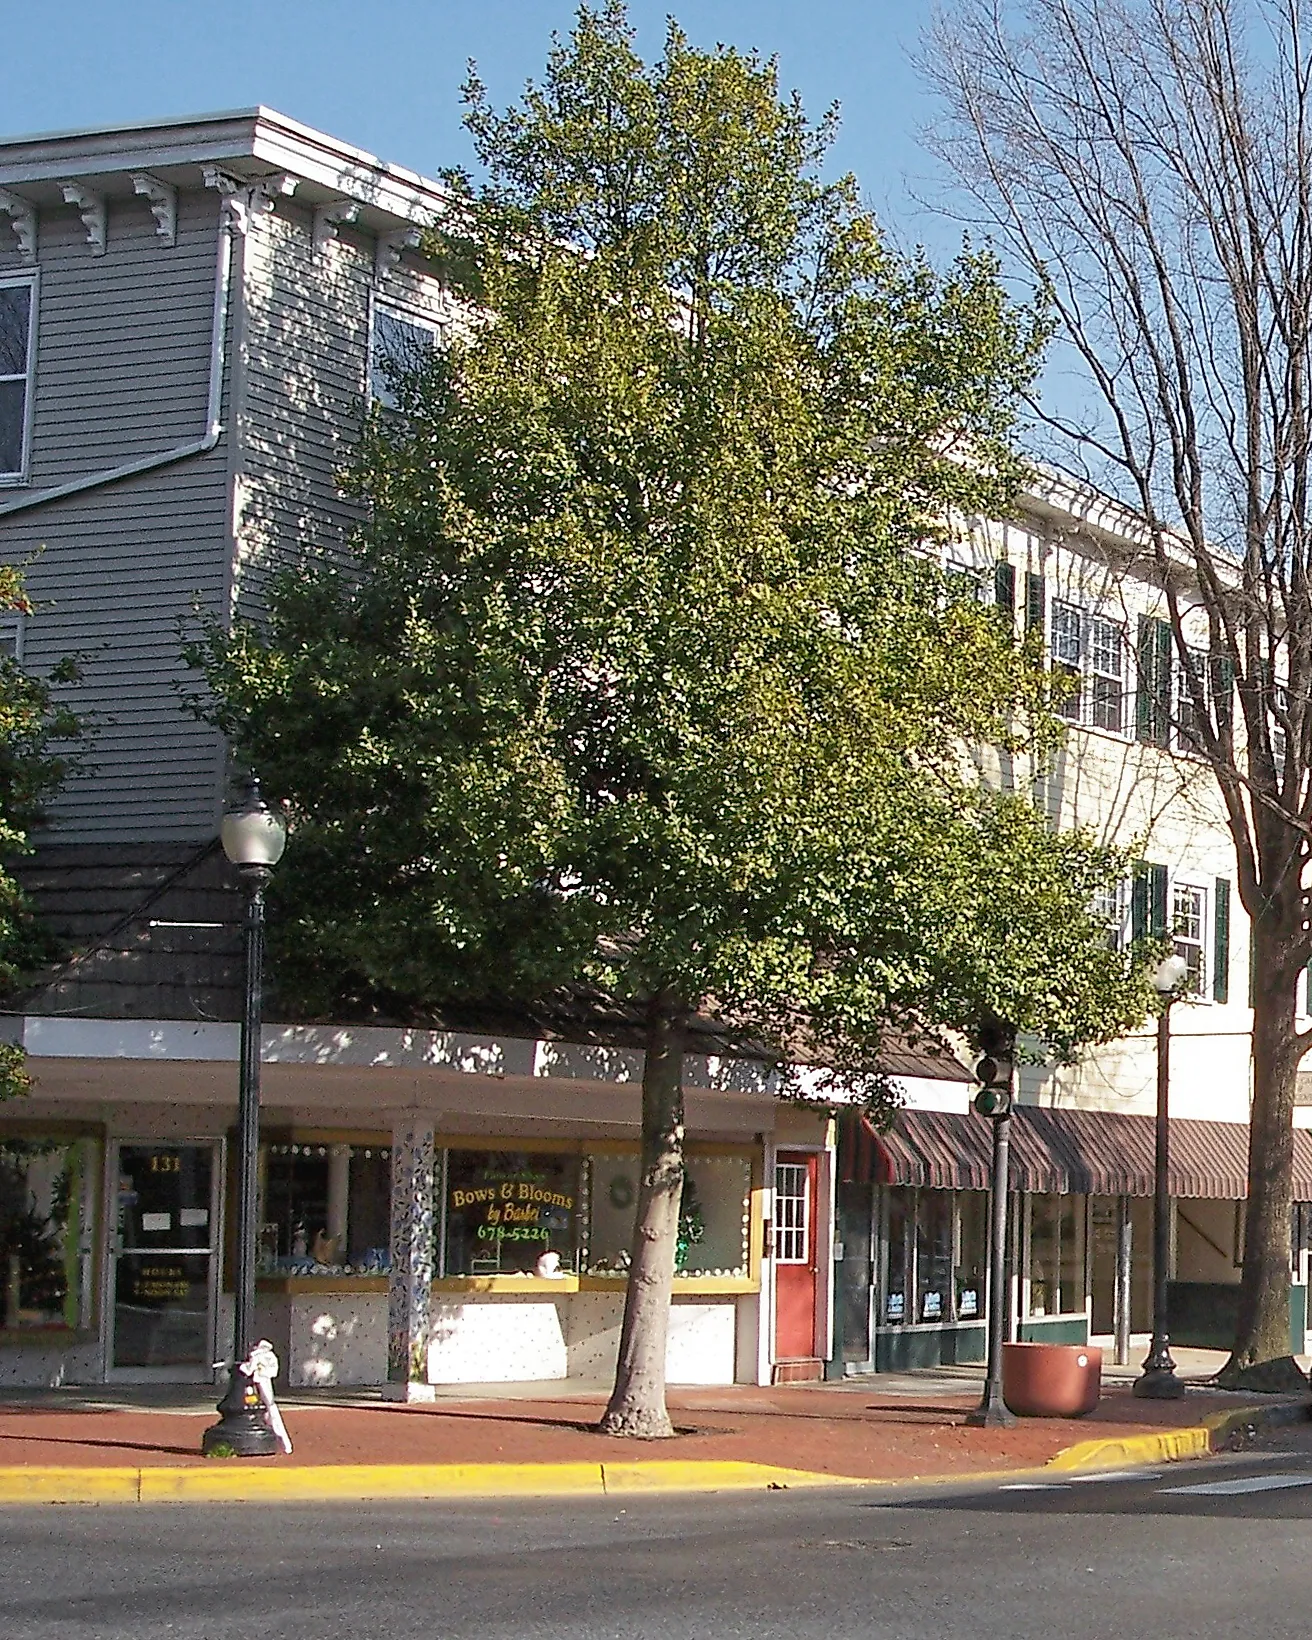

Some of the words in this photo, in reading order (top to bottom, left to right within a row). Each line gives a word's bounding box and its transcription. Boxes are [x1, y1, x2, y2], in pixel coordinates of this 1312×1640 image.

[151, 1156, 180, 1172] 131
[453, 1187, 495, 1207] Bows
[501, 1183, 513, 1199] &
[518, 1183, 573, 1209] Blooms
[487, 1203, 501, 1225] by
[477, 1225, 549, 1241] 678-5226
